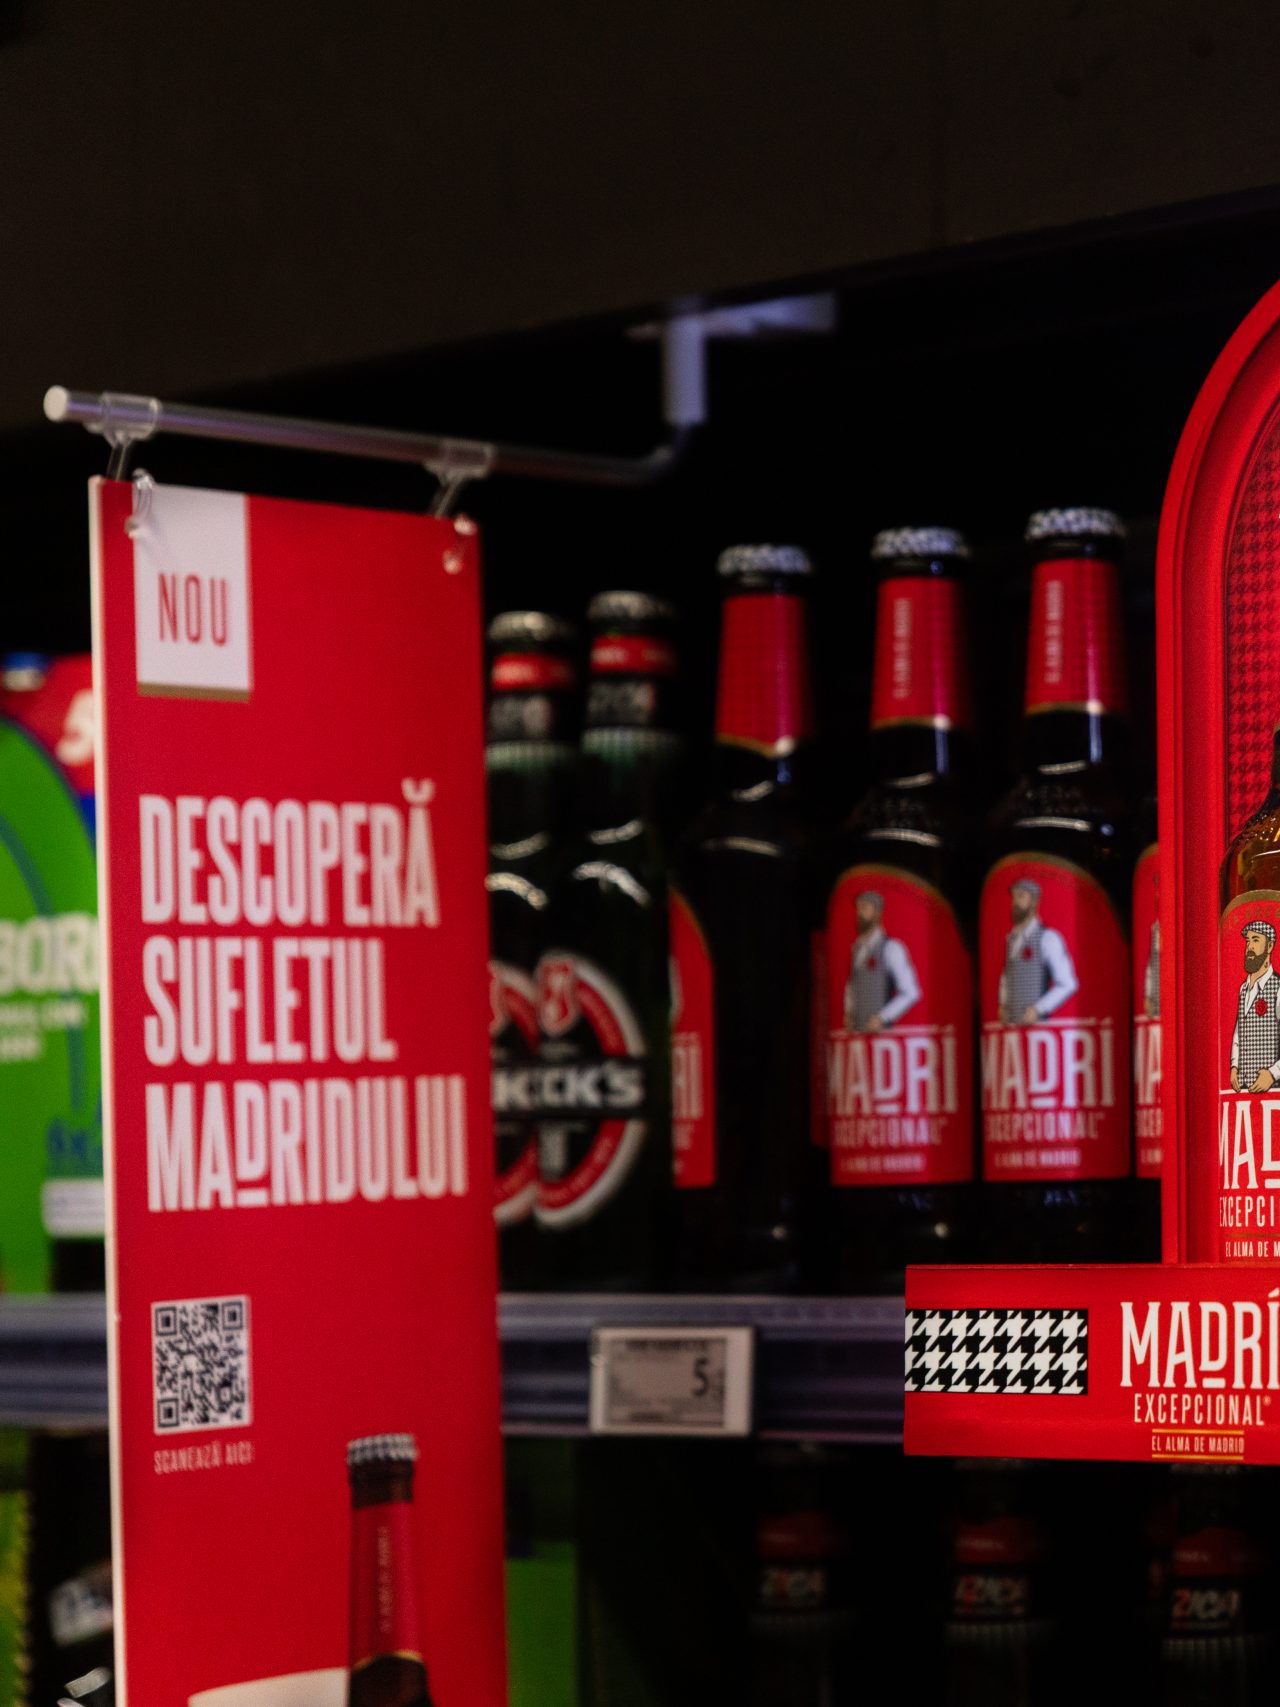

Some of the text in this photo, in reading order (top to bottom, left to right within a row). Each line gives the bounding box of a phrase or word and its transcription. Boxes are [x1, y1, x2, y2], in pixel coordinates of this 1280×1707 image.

[158, 573, 229, 646] NOU
[139, 778, 439, 928] DESCOPERĂ
[143, 936, 397, 1066] SUFLETUL
[145, 1074, 468, 1212] MADRIDULUI
[1233, 1240, 1254, 1257] ALMA
[1257, 1240, 1269, 1257] DE
[1120, 1287, 1280, 1390] MADRÍ
[1152, 1435, 1245, 1454] EL ALMA DE MADRID
